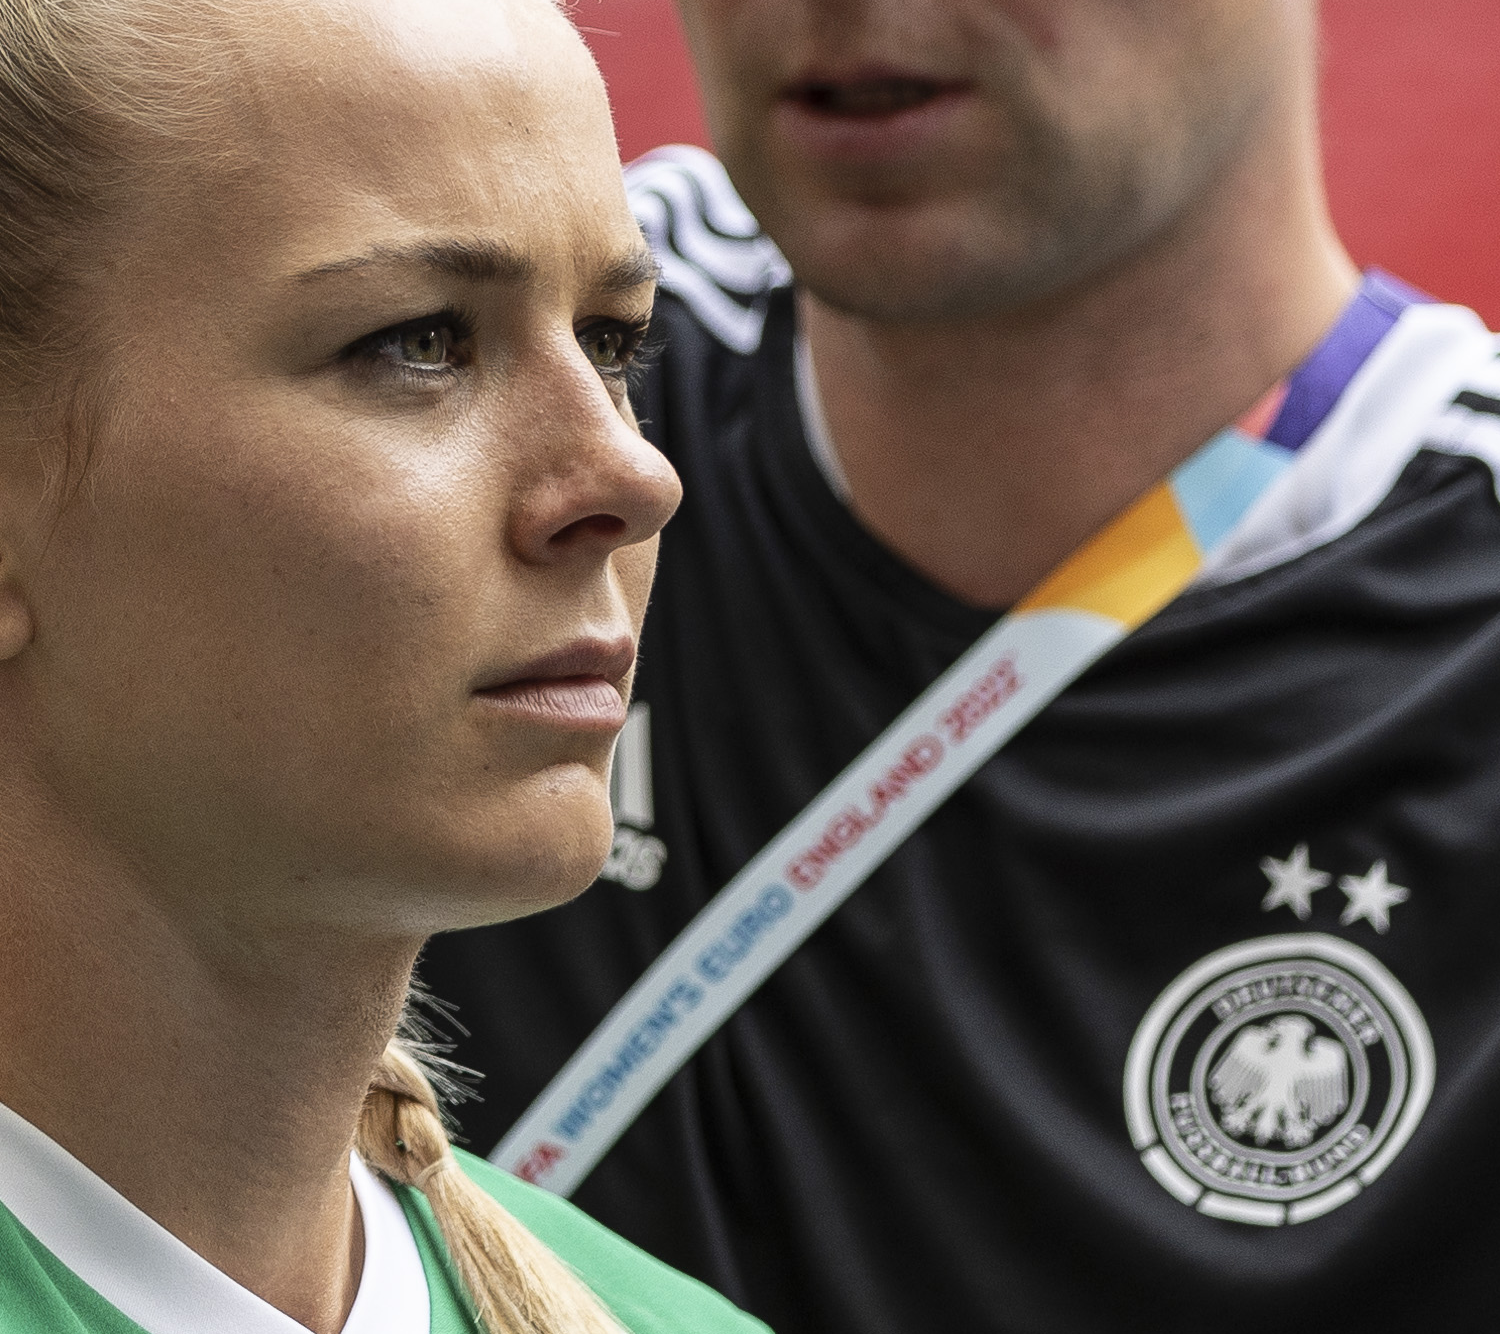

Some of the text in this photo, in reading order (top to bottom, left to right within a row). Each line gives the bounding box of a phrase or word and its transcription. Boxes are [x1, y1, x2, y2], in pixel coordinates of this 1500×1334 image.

[514, 1140, 567, 1185] FA
[554, 975, 704, 1141] WOMEN'S
[696, 883, 795, 984] EURO
[785, 733, 945, 892] ENGLAND
[936, 651, 1024, 746] 2022
